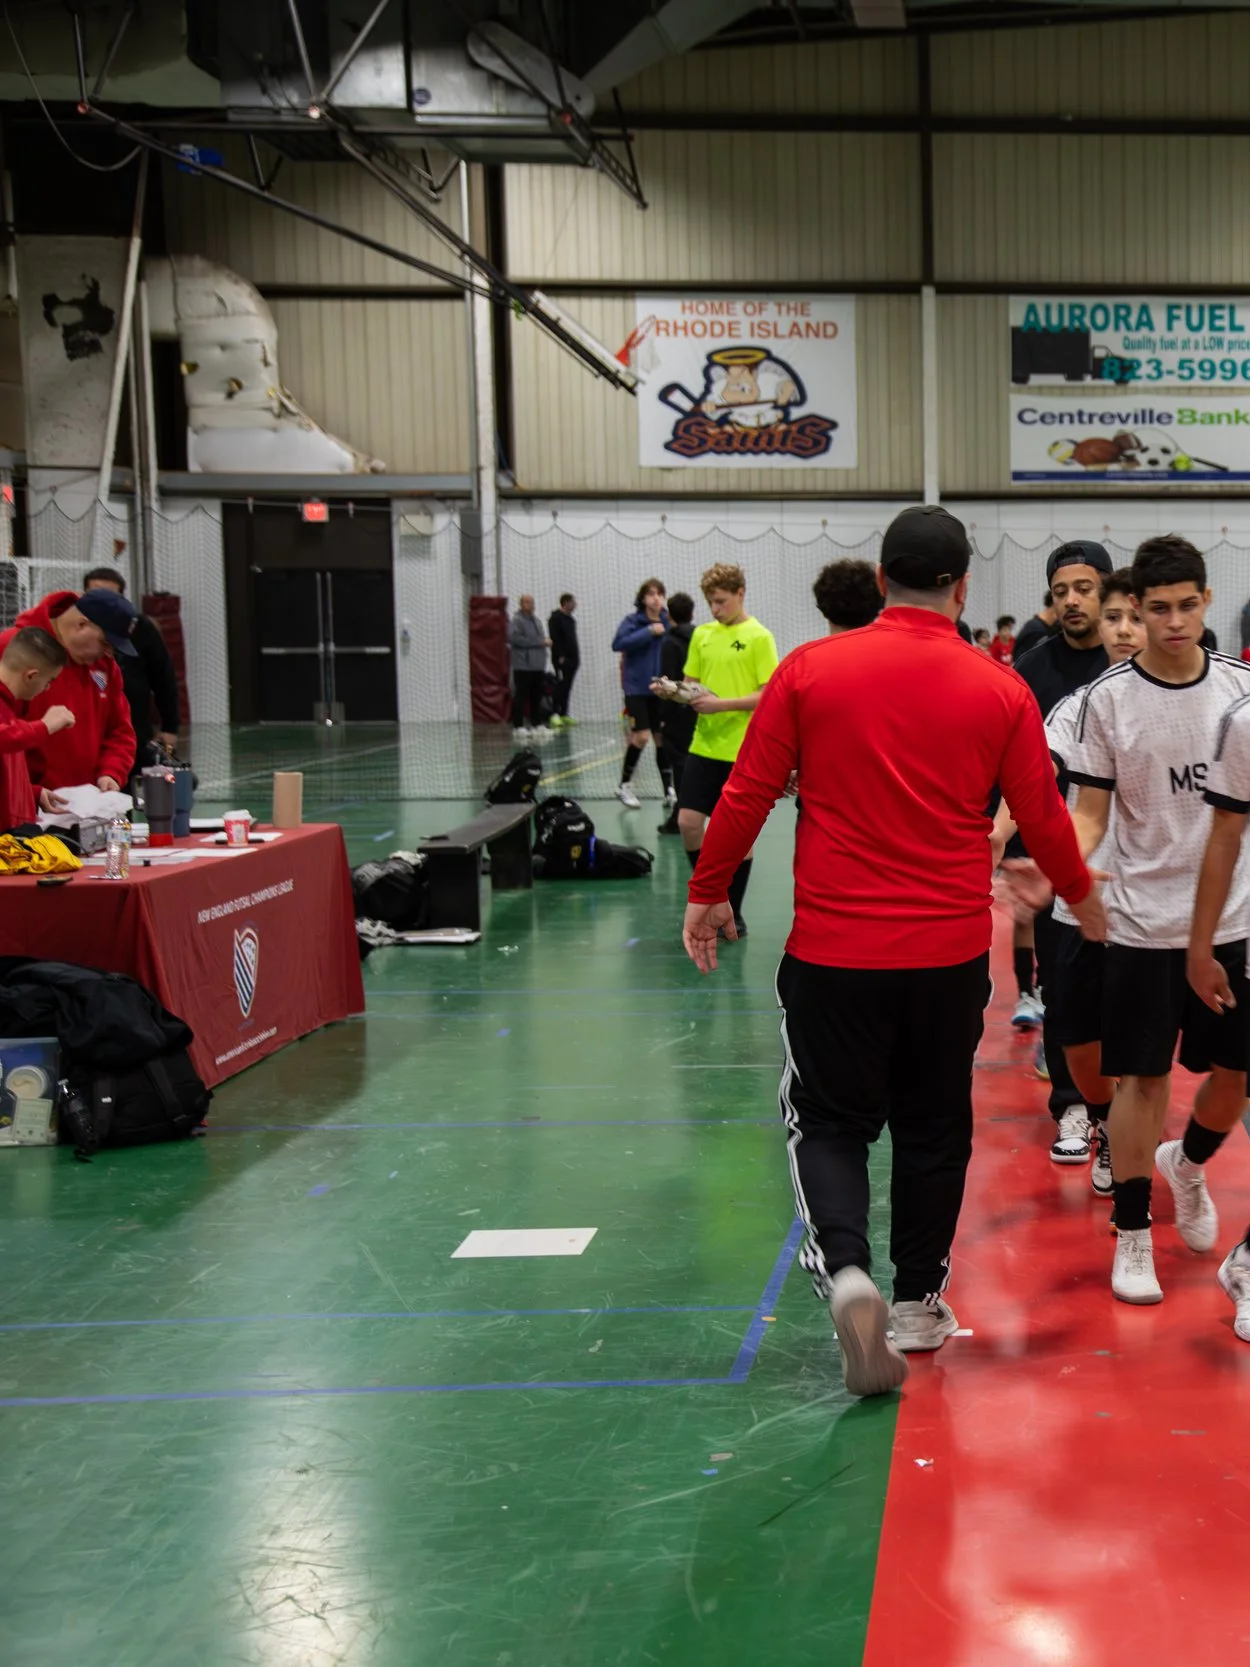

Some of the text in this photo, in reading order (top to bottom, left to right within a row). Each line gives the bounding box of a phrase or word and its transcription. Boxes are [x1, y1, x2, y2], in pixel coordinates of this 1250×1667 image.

[681, 302, 812, 316] HOME OF THE
[1020, 303, 1245, 332] AURORA FUEL
[655, 320, 839, 339] RHODE ISLAND
[1123, 335, 1157, 354] Quality
[1160, 336, 1178, 350] fuel
[1181, 337, 1191, 350] at
[1193, 341, 1200, 350] a
[1203, 336, 1225, 350] LOW
[1017, 408, 1250, 425] Centreville Bank
[1170, 763, 1207, 794] MS
